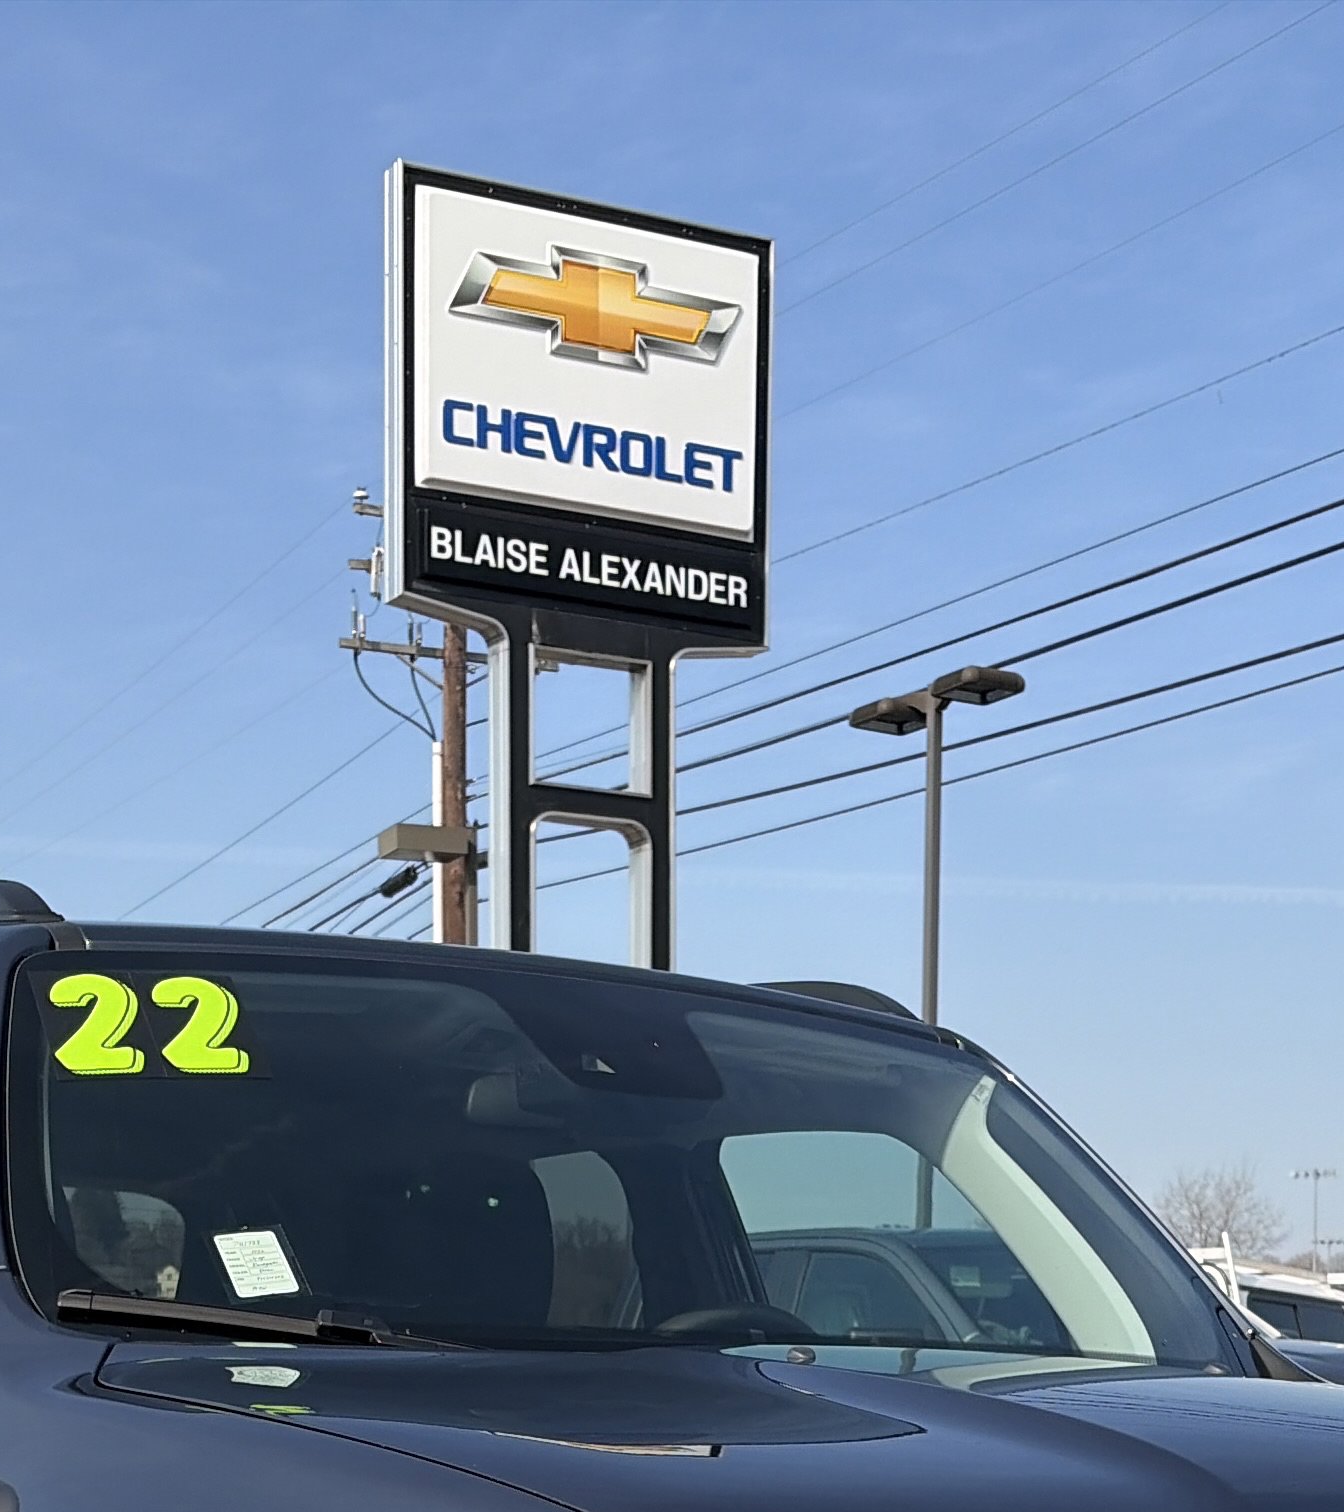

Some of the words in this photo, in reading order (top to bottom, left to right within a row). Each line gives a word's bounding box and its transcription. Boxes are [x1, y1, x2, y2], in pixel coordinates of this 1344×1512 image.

[442, 398, 743, 493] CHEVROLET
[430, 525, 549, 577] BLAISE
[558, 548, 748, 608] ALEXANDER
[48, 973, 251, 1076] 22
